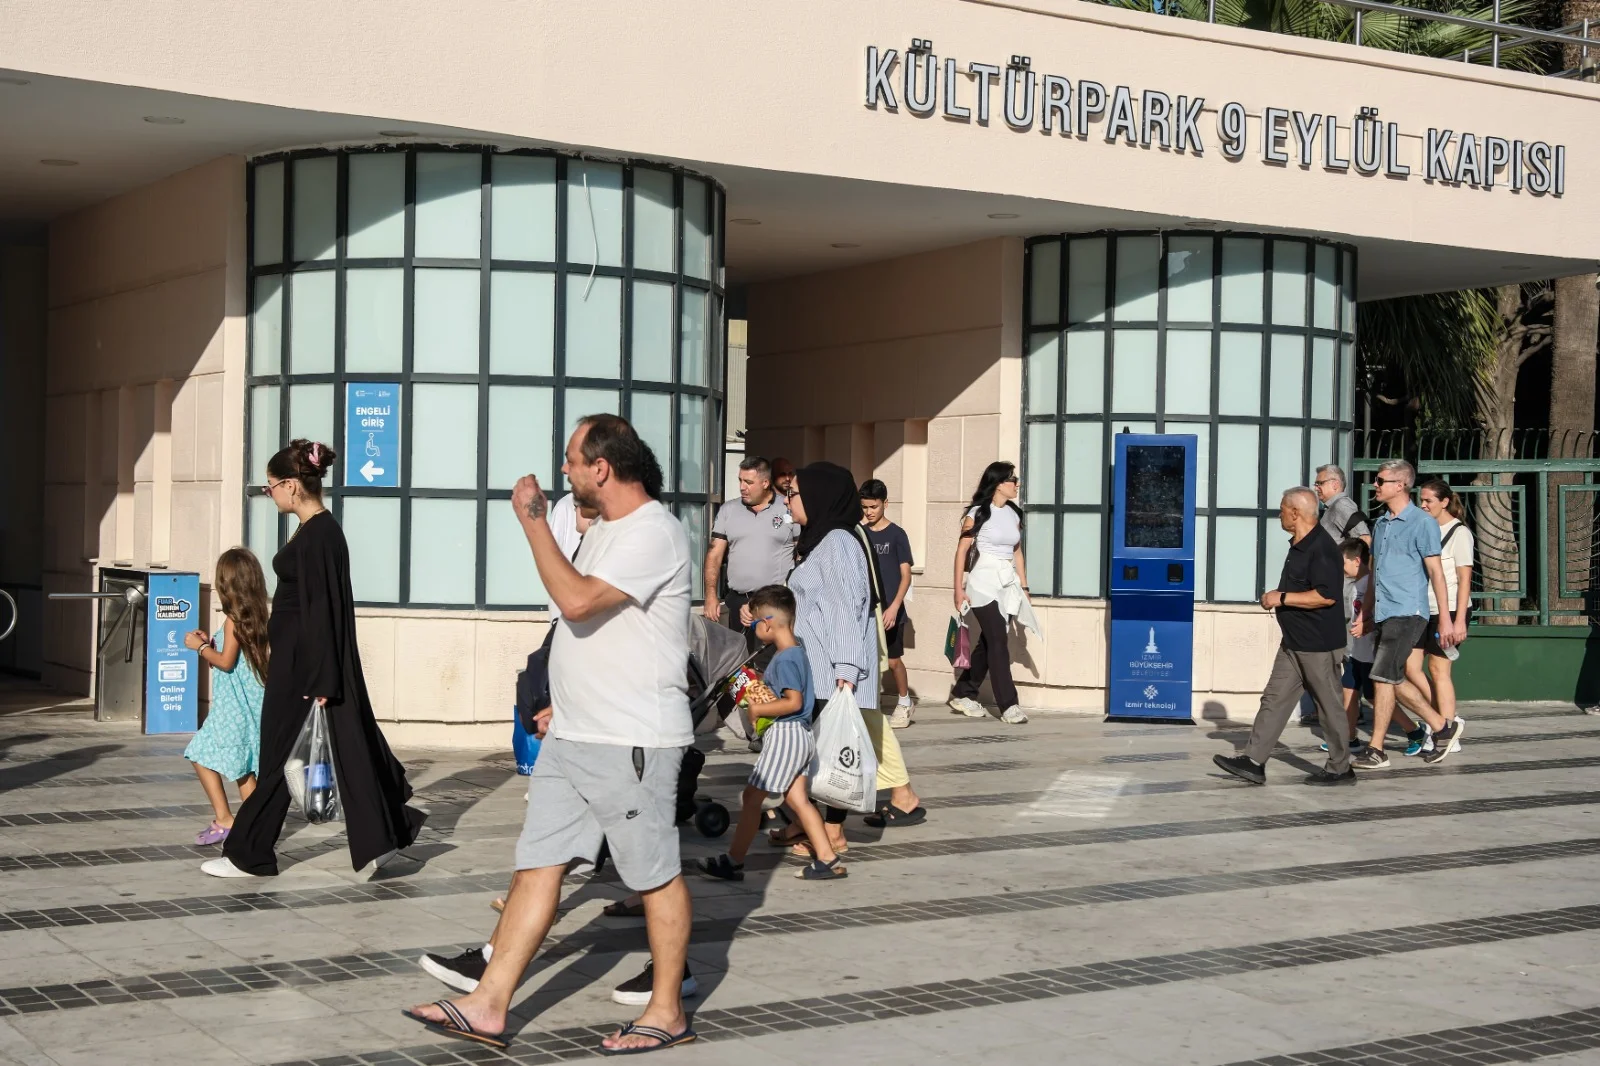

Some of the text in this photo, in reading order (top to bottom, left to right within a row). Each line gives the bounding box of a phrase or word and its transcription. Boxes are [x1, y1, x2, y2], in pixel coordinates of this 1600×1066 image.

[865, 38, 1566, 195] KÜLTÜRPARK 9 EYLÜL KAPISI
[356, 405, 391, 416] ENGELLİ
[361, 417, 385, 429] GİRİŞ
[160, 694, 183, 702] Biletli
[163, 703, 182, 711] Giriş
[1144, 702, 1176, 710] teknoloji
